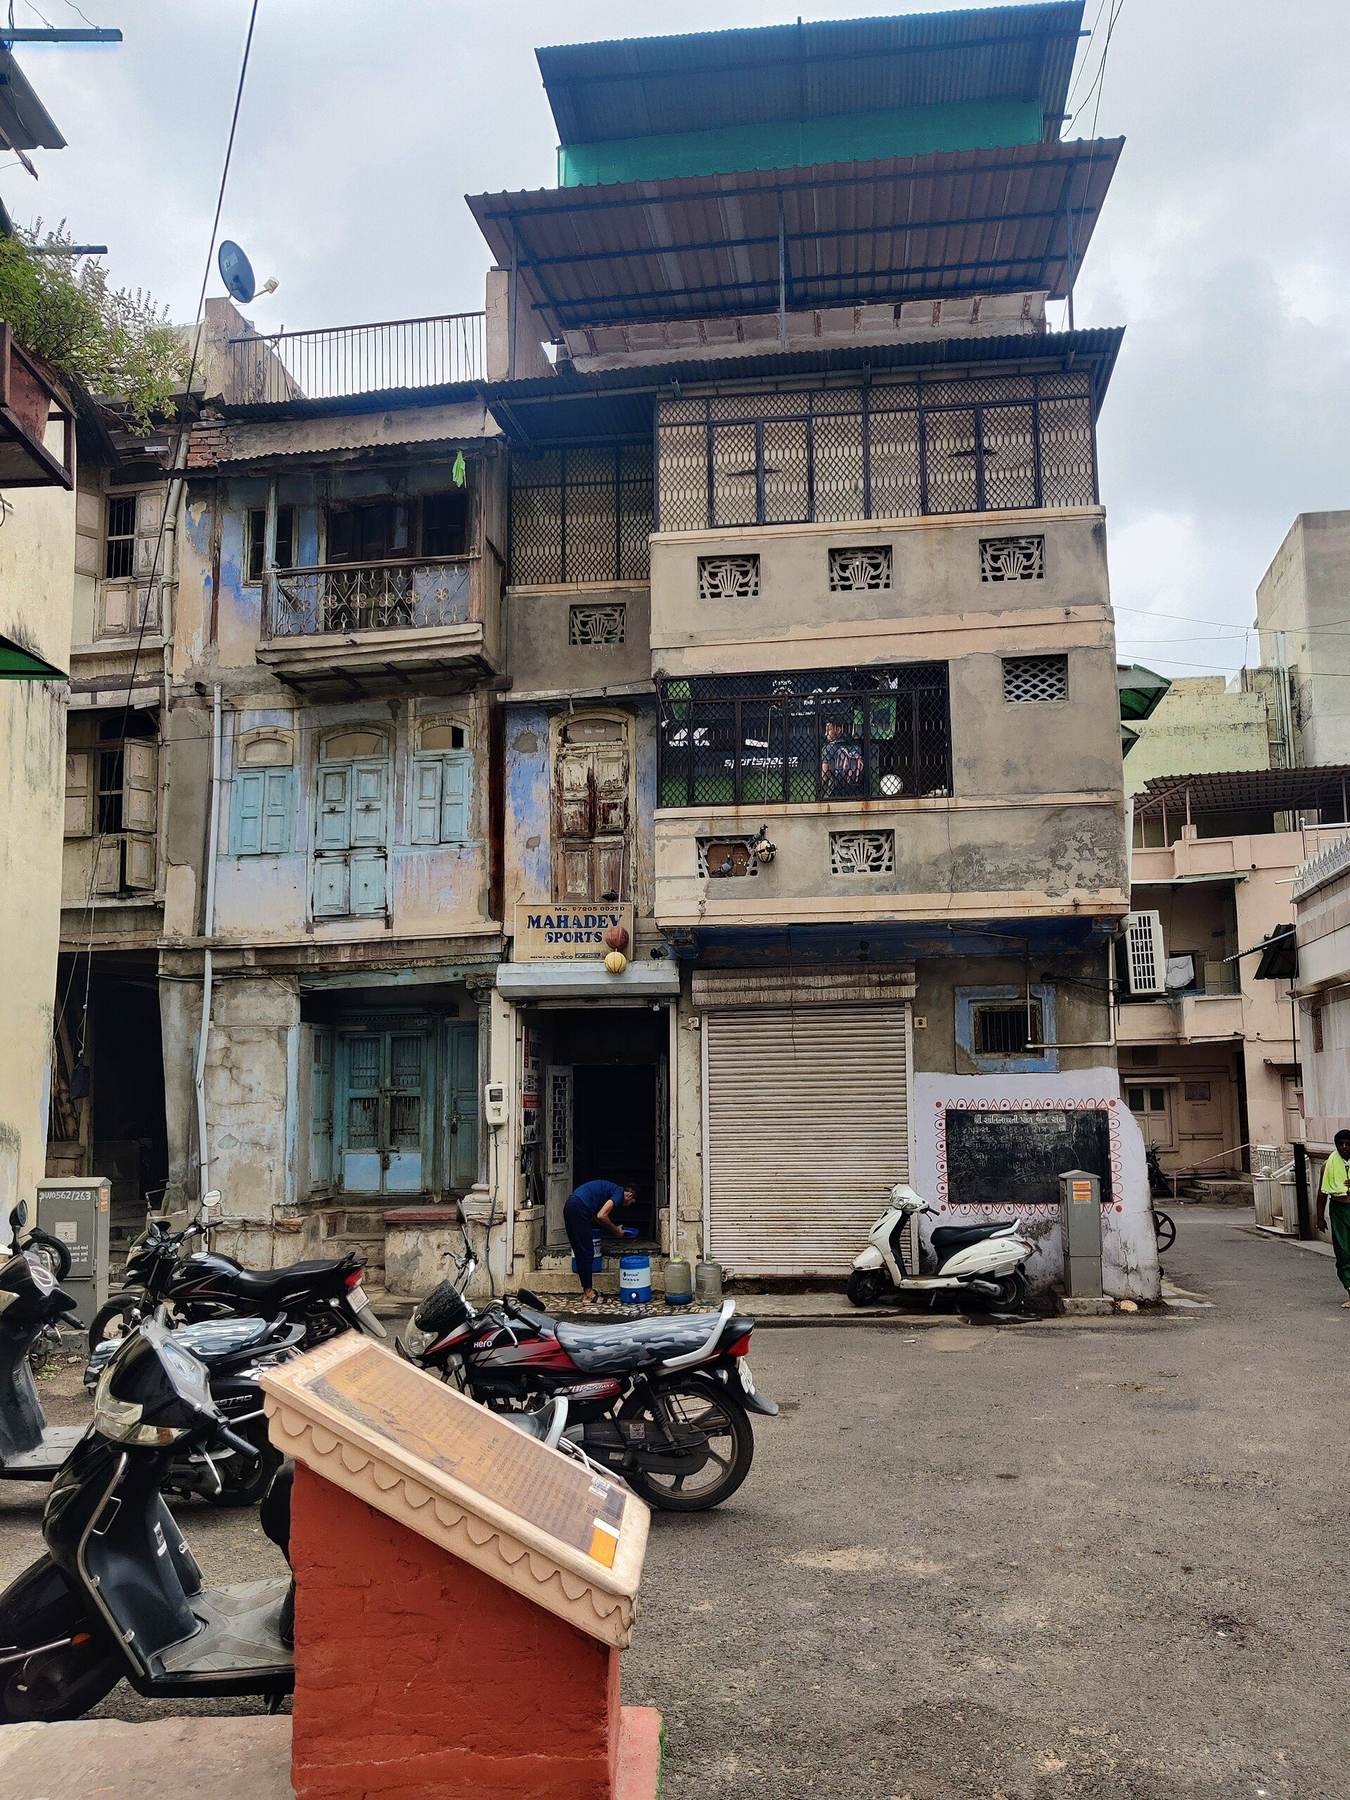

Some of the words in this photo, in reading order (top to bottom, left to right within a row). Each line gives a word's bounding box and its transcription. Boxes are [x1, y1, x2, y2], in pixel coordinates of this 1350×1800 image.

[724, 756, 798, 769] sortspacz
[527, 914, 623, 929] MAHADEV
[545, 931, 603, 943] SPORTS
[473, 1340, 493, 1349] Hero
